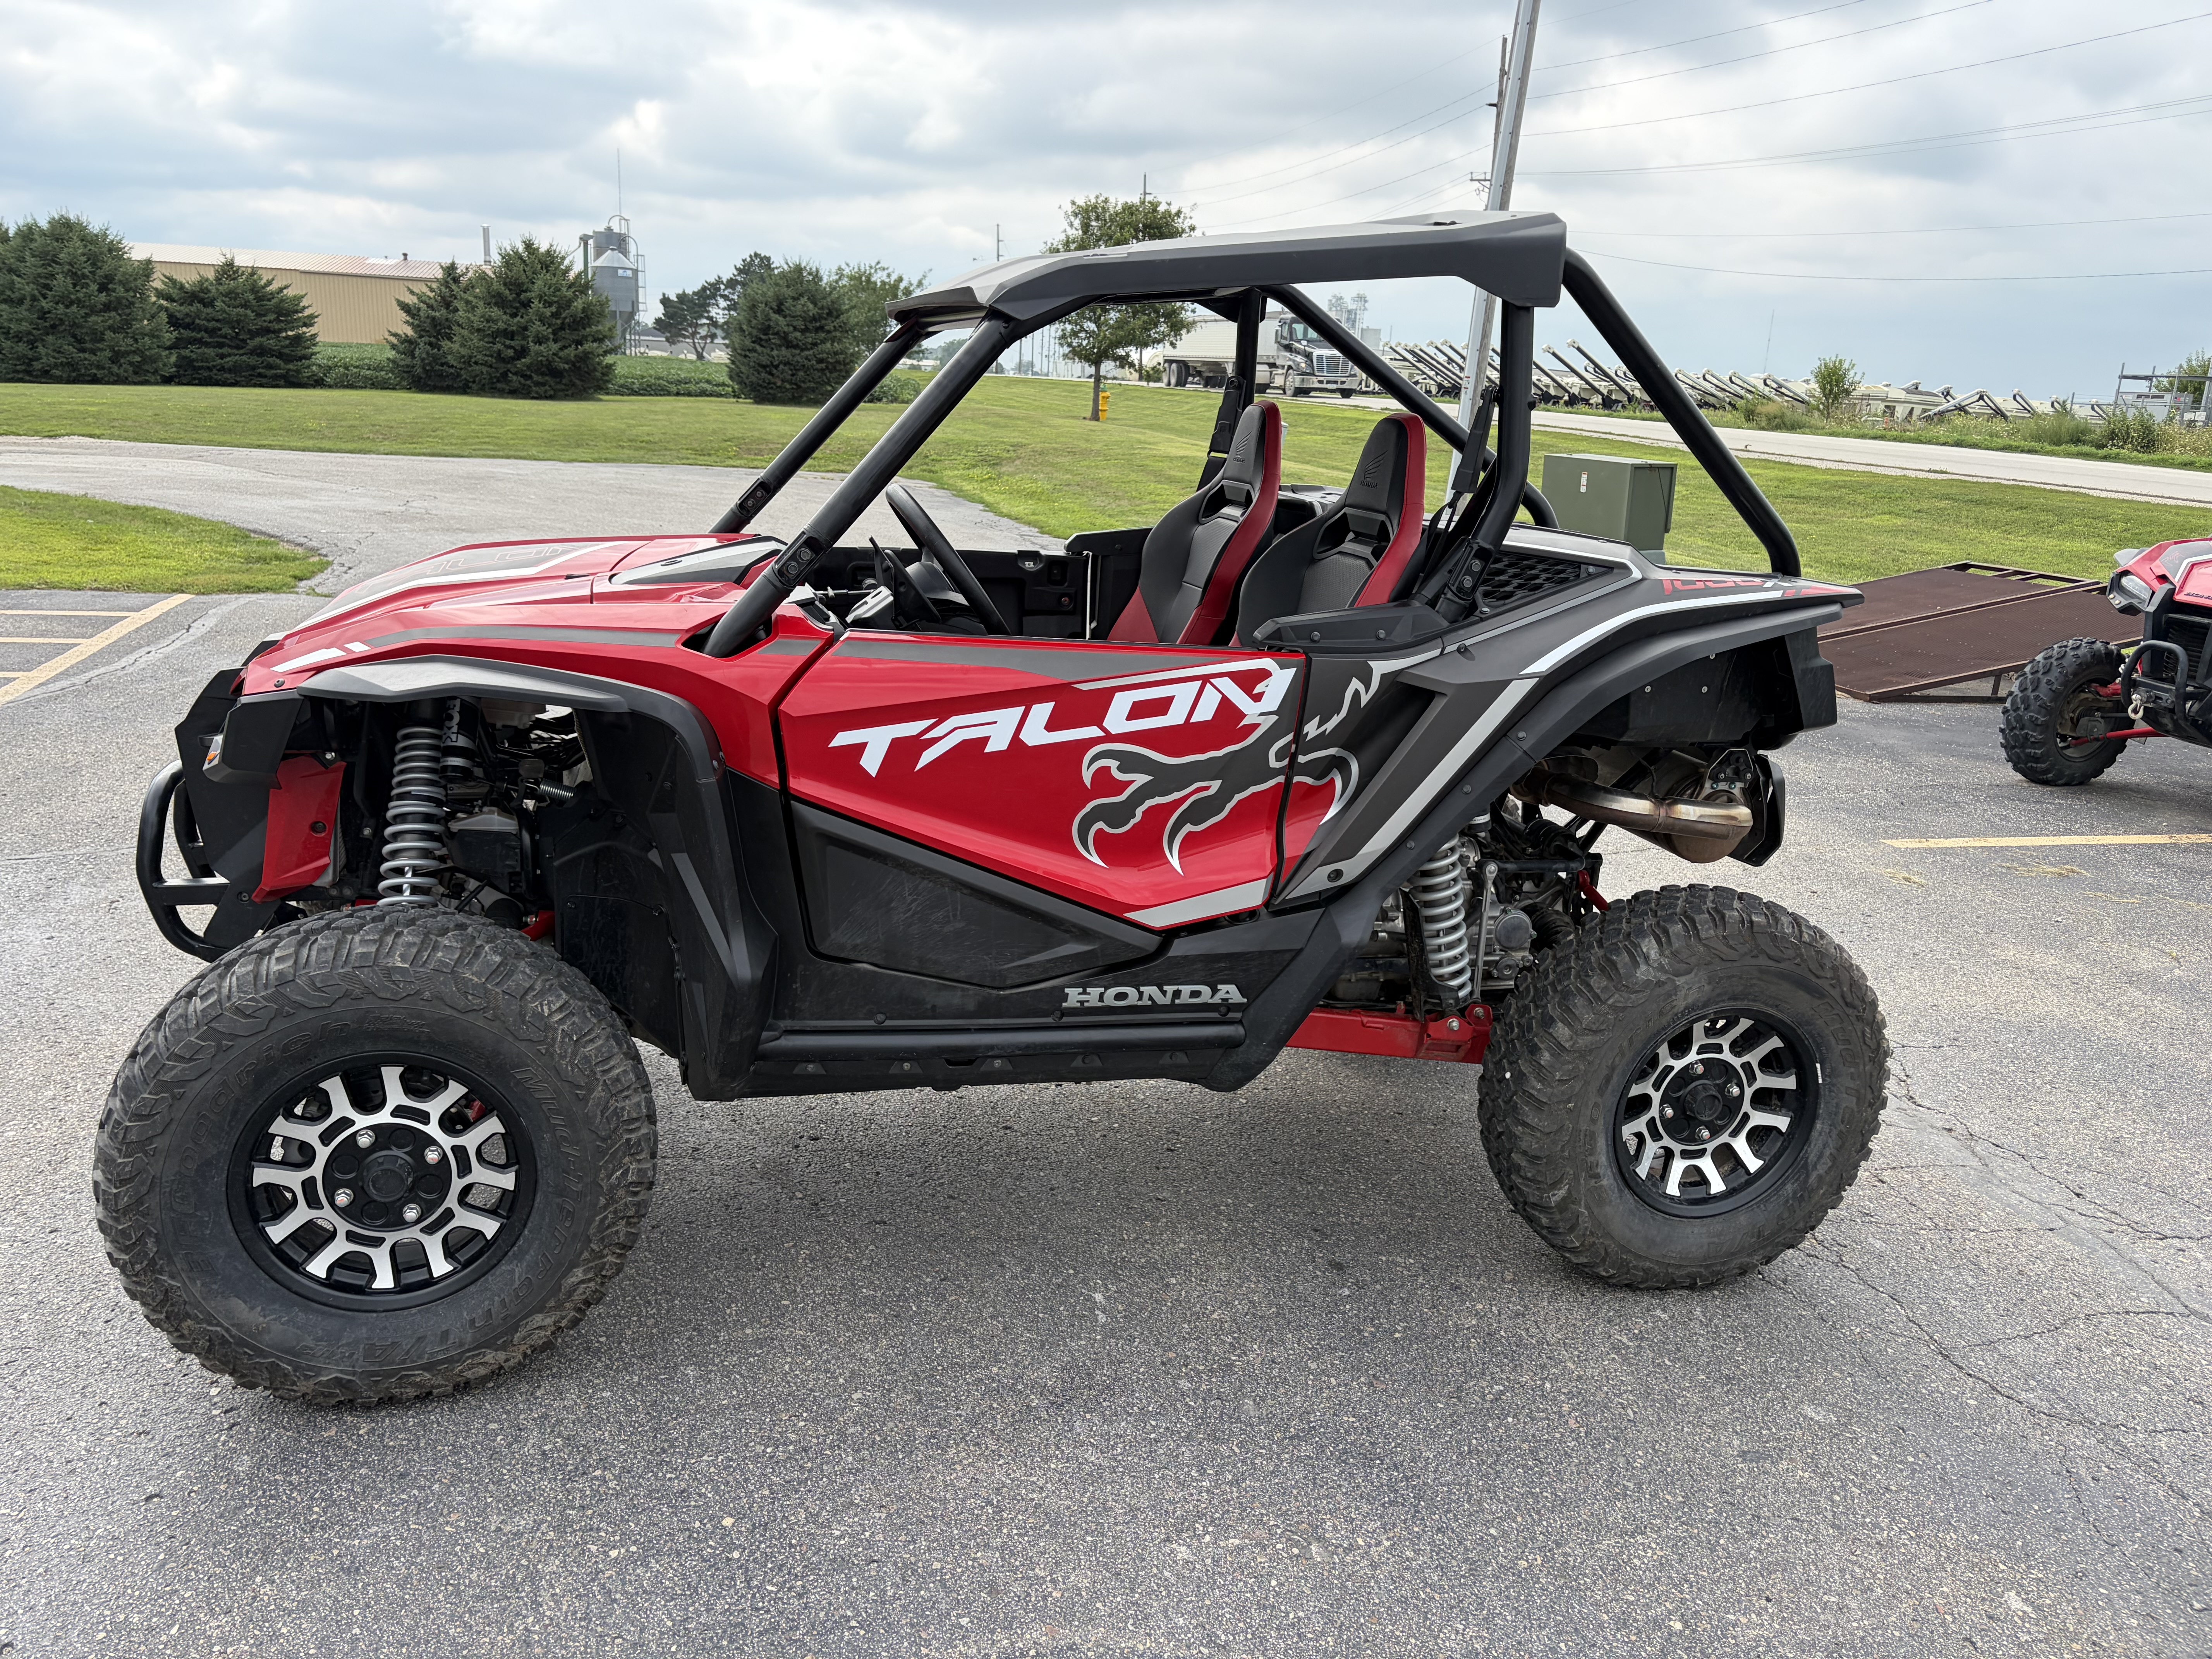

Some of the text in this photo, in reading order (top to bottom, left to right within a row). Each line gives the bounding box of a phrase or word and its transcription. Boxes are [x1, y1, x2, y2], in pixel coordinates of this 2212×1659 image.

[1360, 480, 1378, 489] HONDA
[1661, 577, 1794, 595] 1000X
[442, 698, 461, 744] FOX
[828, 667, 1297, 778] TALON
[1062, 984, 1248, 1008] HONDA
[467, 1066, 583, 1333] Mud-Terrain
